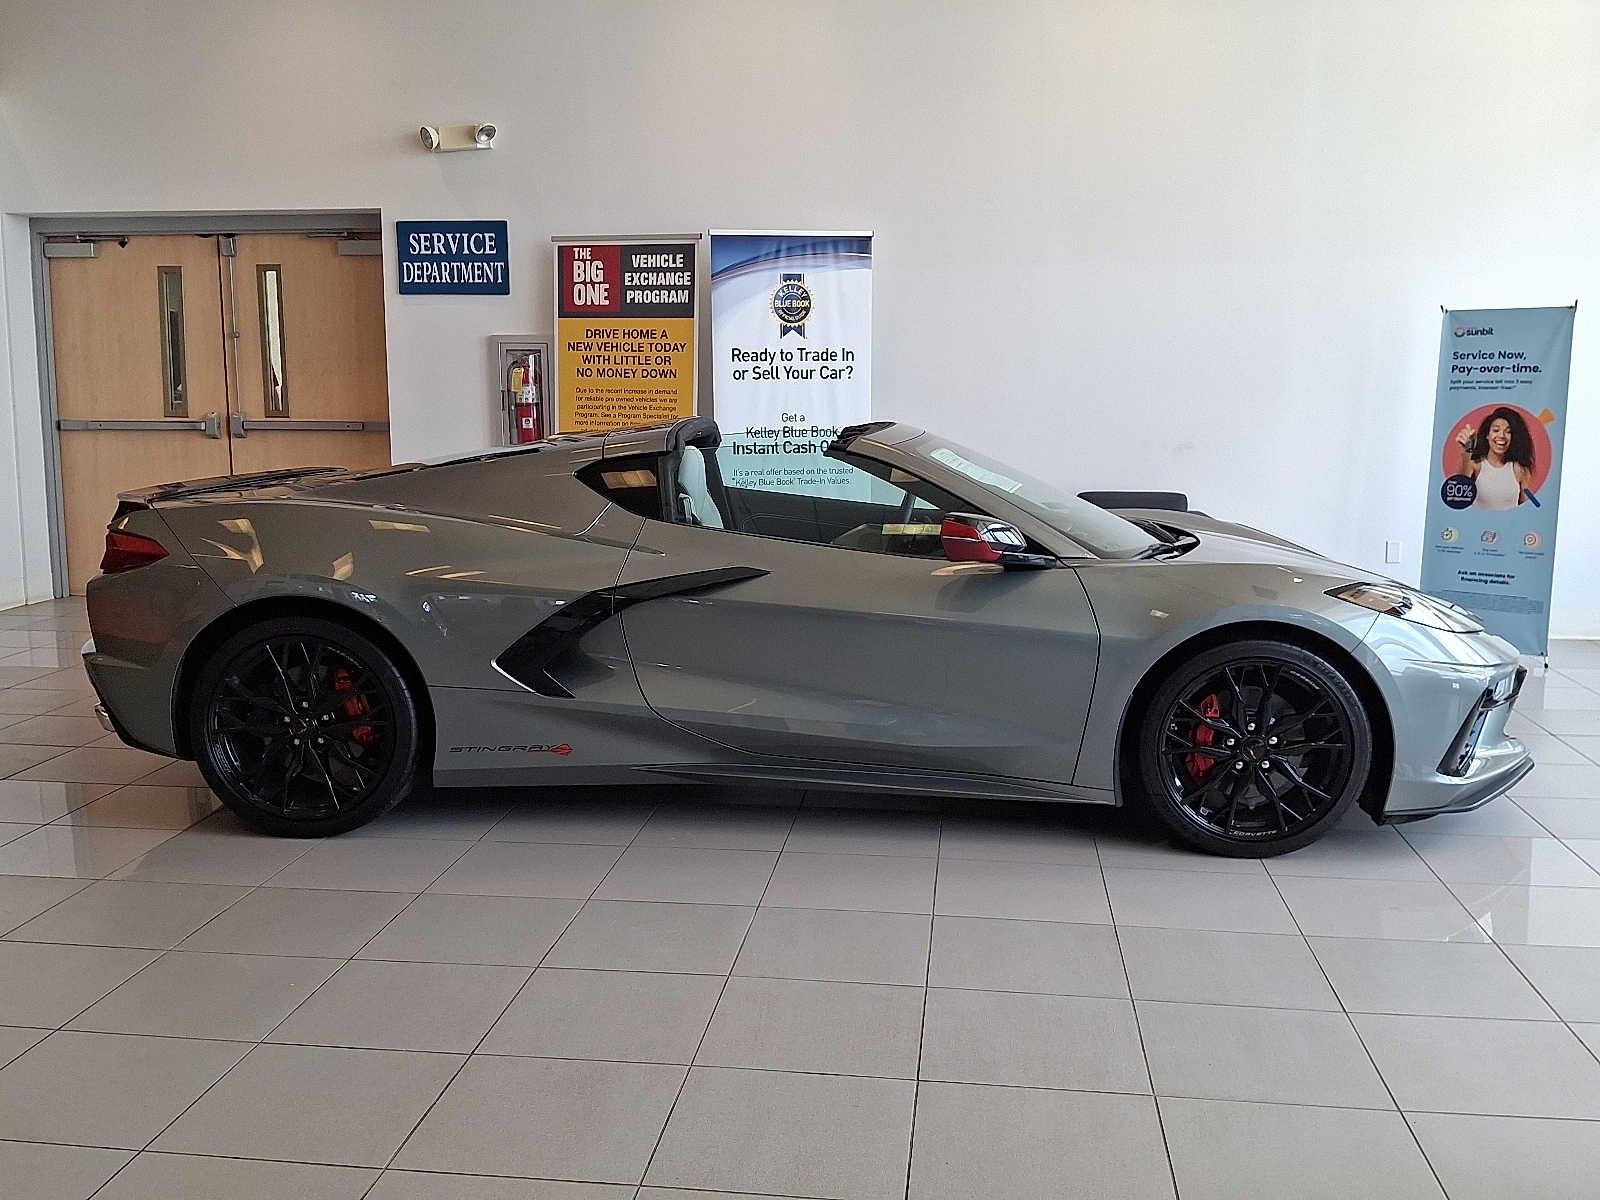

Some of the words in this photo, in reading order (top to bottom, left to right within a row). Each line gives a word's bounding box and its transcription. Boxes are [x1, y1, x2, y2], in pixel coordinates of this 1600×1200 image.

[409, 232, 497, 255] SERVICE
[572, 247, 592, 260] THE
[631, 254, 684, 268] VEHICLE
[402, 261, 505, 283] DEPARTMENT
[572, 260, 604, 283] BIG
[624, 271, 692, 286] EXCHANGE
[572, 283, 610, 306] ONE
[626, 290, 689, 304] PROGRAM
[778, 285, 808, 297] KELLEY
[774, 299, 792, 308] BLUE
[791, 299, 810, 308] BOOK
[585, 328, 620, 339] DRIVE
[622, 329, 657, 340] HOME
[660, 329, 669, 340] A
[1466, 327, 1494, 337] sunbit
[567, 341, 594, 352] NEW
[596, 342, 645, 353] VEHICLE
[648, 342, 687, 353] TODAY
[582, 354, 611, 365] WITH
[613, 355, 652, 366] LITTLE
[654, 355, 672, 366] OR
[731, 347, 776, 366] Ready
[779, 348, 794, 362] to
[797, 347, 838, 362] Trade
[841, 347, 855, 362] In
[1452, 349, 1495, 360] Service
[1497, 350, 1527, 361] Now,
[576, 367, 593, 378] NO
[596, 368, 637, 379] MONEY
[641, 368, 677, 379] DOWN
[732, 369, 749, 380] or
[752, 365, 781, 380] Sell
[782, 365, 817, 380] Your
[819, 365, 854, 380] Car?
[1451, 363, 1542, 376] Pay-over-time.
[575, 386, 587, 394] Due
[648, 405, 677, 413] Exchange
[617, 412, 642, 421] Program
[781, 412, 798, 423] Get
[745, 426, 780, 441] Kelley
[782, 425, 808, 438] Blue
[810, 425, 838, 438] Book
[732, 441, 780, 455] Instant
[782, 440, 817, 454] Cash
[733, 468, 743, 477] It's
[766, 468, 781, 476] offer
[783, 467, 805, 476] based
[816, 467, 828, 475] the
[828, 466, 854, 475] trusted
[758, 478, 775, 486] Blue
[1446, 484, 1473, 497] 90%
[448, 744, 558, 753] STINGRAY
[1232, 829, 1278, 837] CORVETTE
